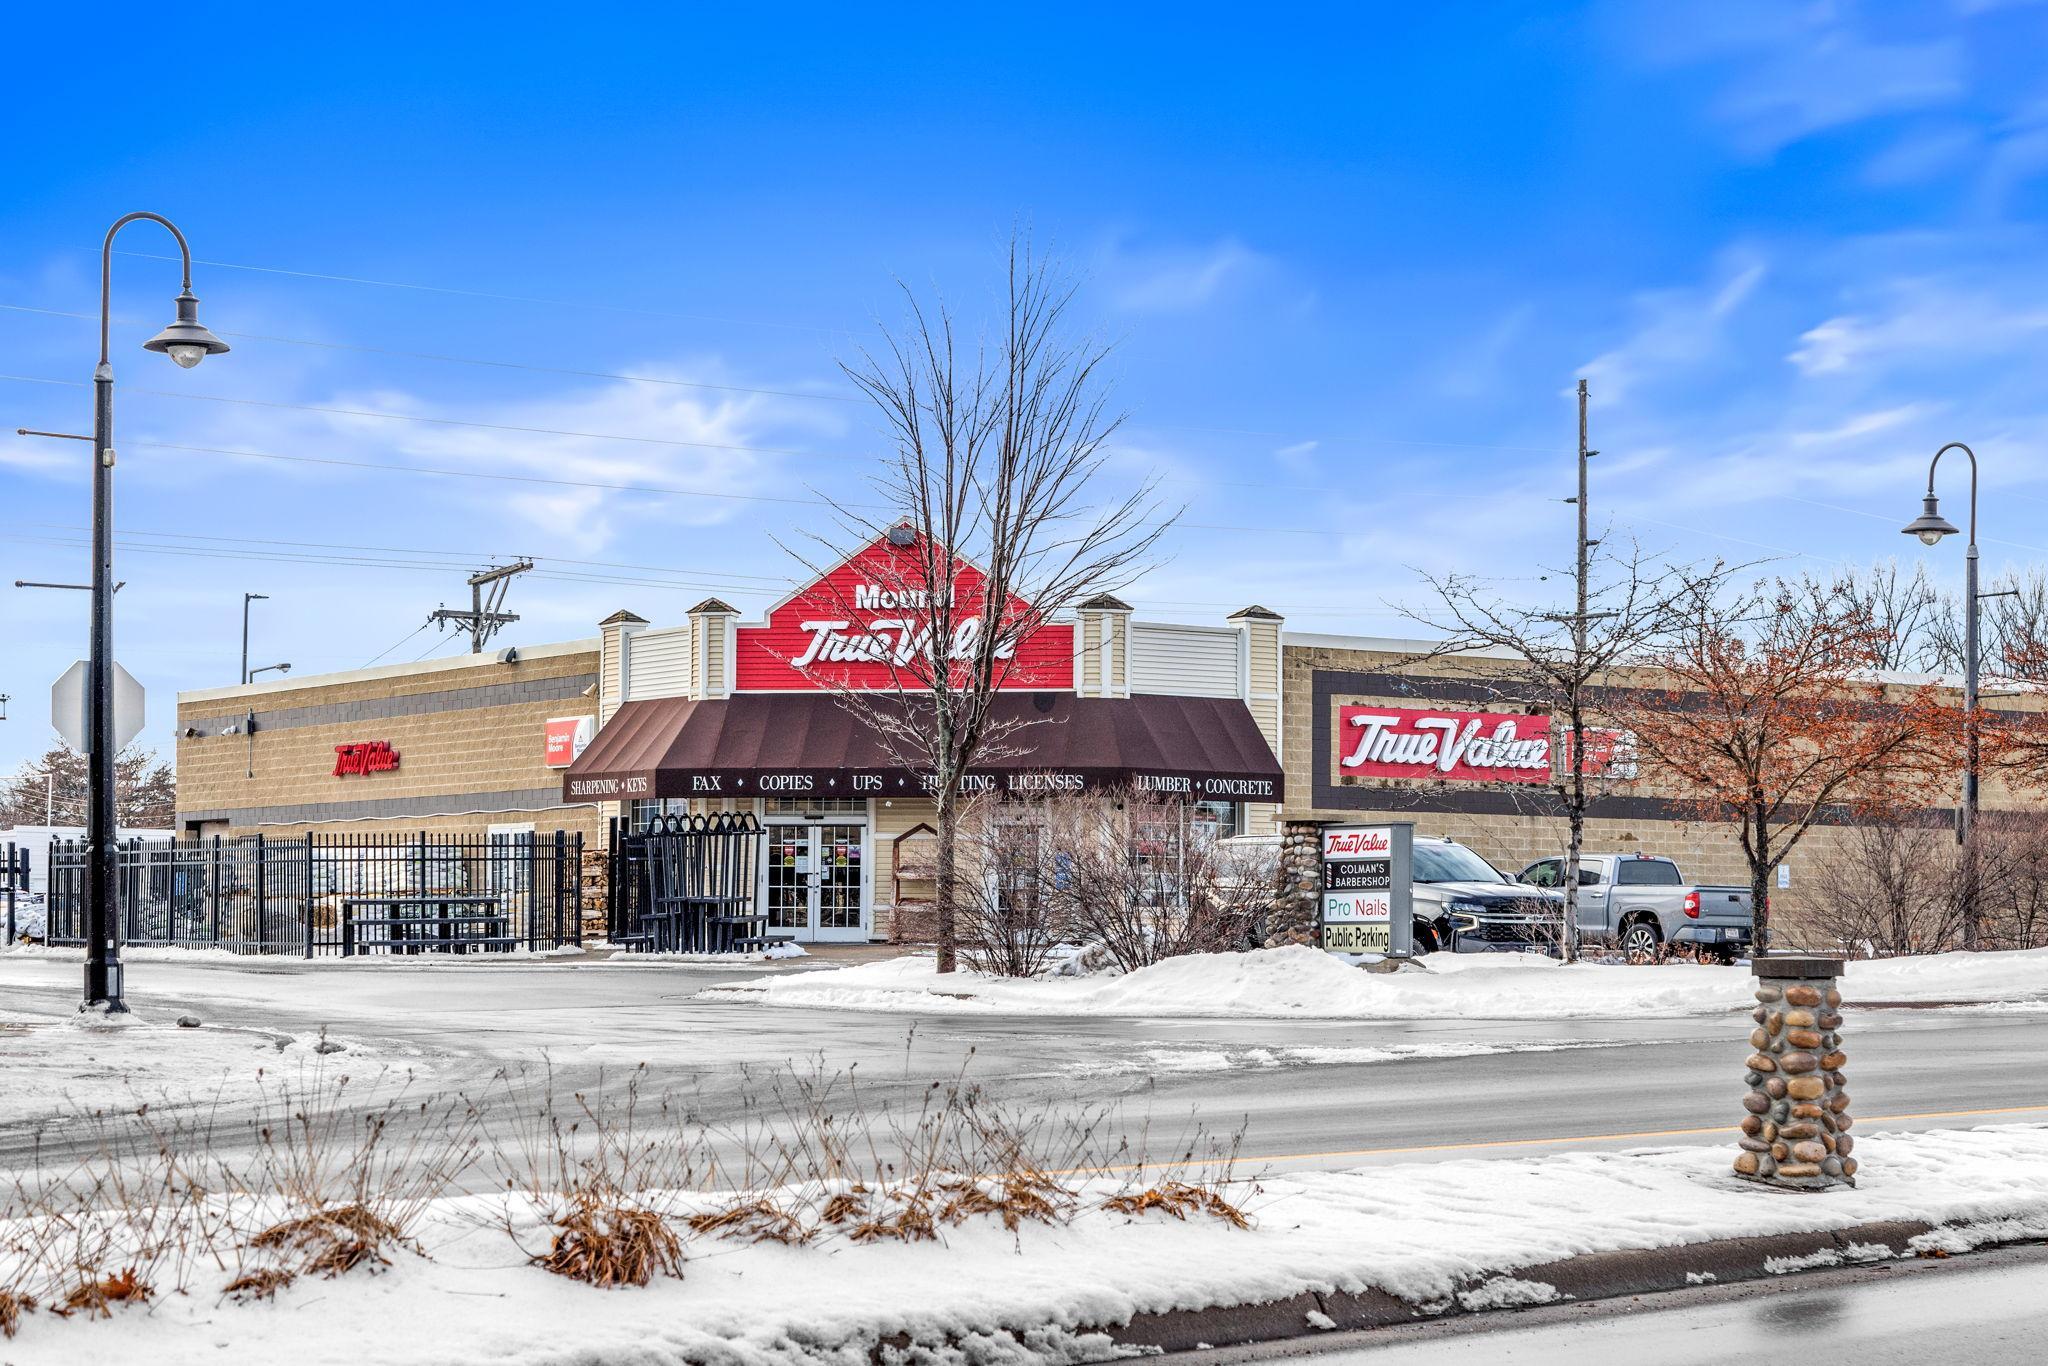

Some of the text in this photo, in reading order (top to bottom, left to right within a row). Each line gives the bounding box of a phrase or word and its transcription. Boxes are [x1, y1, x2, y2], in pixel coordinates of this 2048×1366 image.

[571, 777, 647, 796] SHARPENING KEYS
[692, 775, 1084, 791] FAX COPIES UPS HTING LICENSES
[1137, 775, 1273, 796] LUMBER CONCRETE
[1340, 863, 1385, 874] COLMAN'S
[1335, 876, 1390, 887] BARBERSHOP
[1328, 898, 1388, 916] Pro Nails
[1326, 926, 1389, 952] Public Parking
